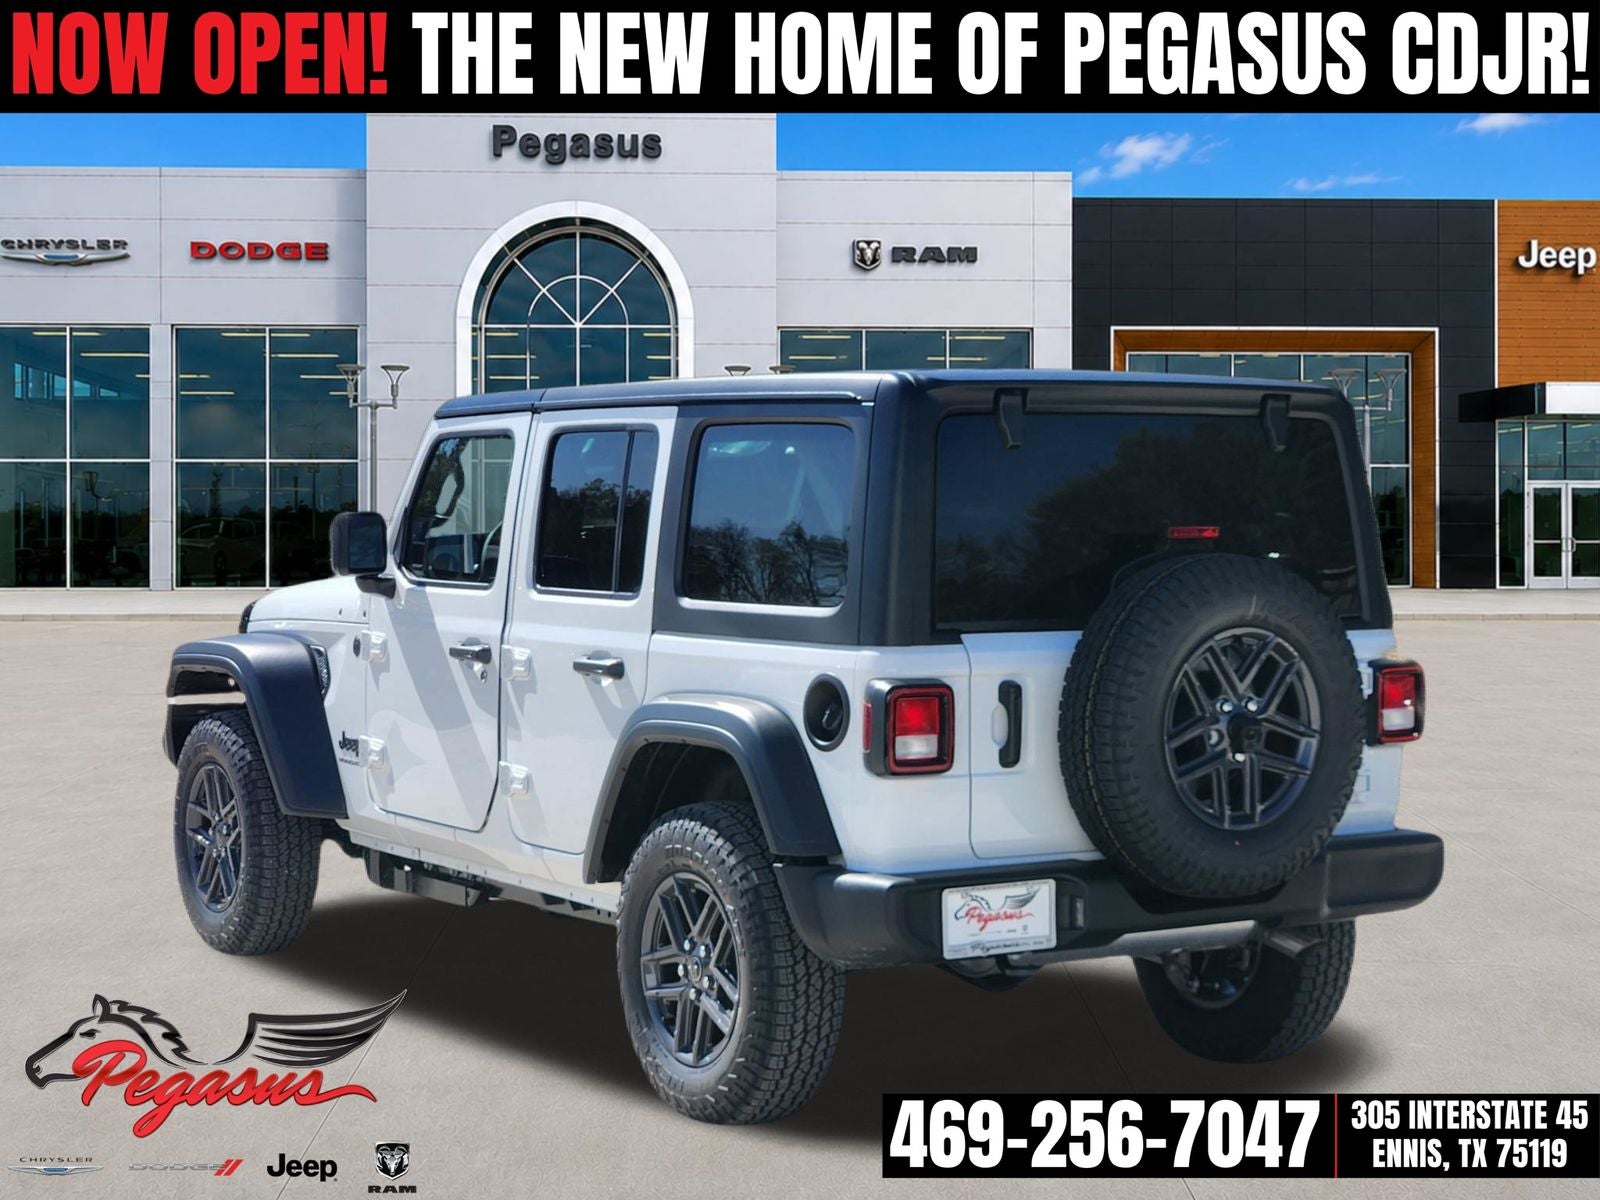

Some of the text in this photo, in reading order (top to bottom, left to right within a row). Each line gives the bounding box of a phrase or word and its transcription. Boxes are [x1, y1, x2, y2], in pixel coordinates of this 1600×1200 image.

[492, 124, 662, 166] Pegasus
[0, 239, 129, 250] CHRYSLER
[190, 241, 328, 260] DODGE
[891, 246, 978, 263] RAM
[1517, 239, 1597, 275] Jeep
[338, 730, 360, 758] Jeep
